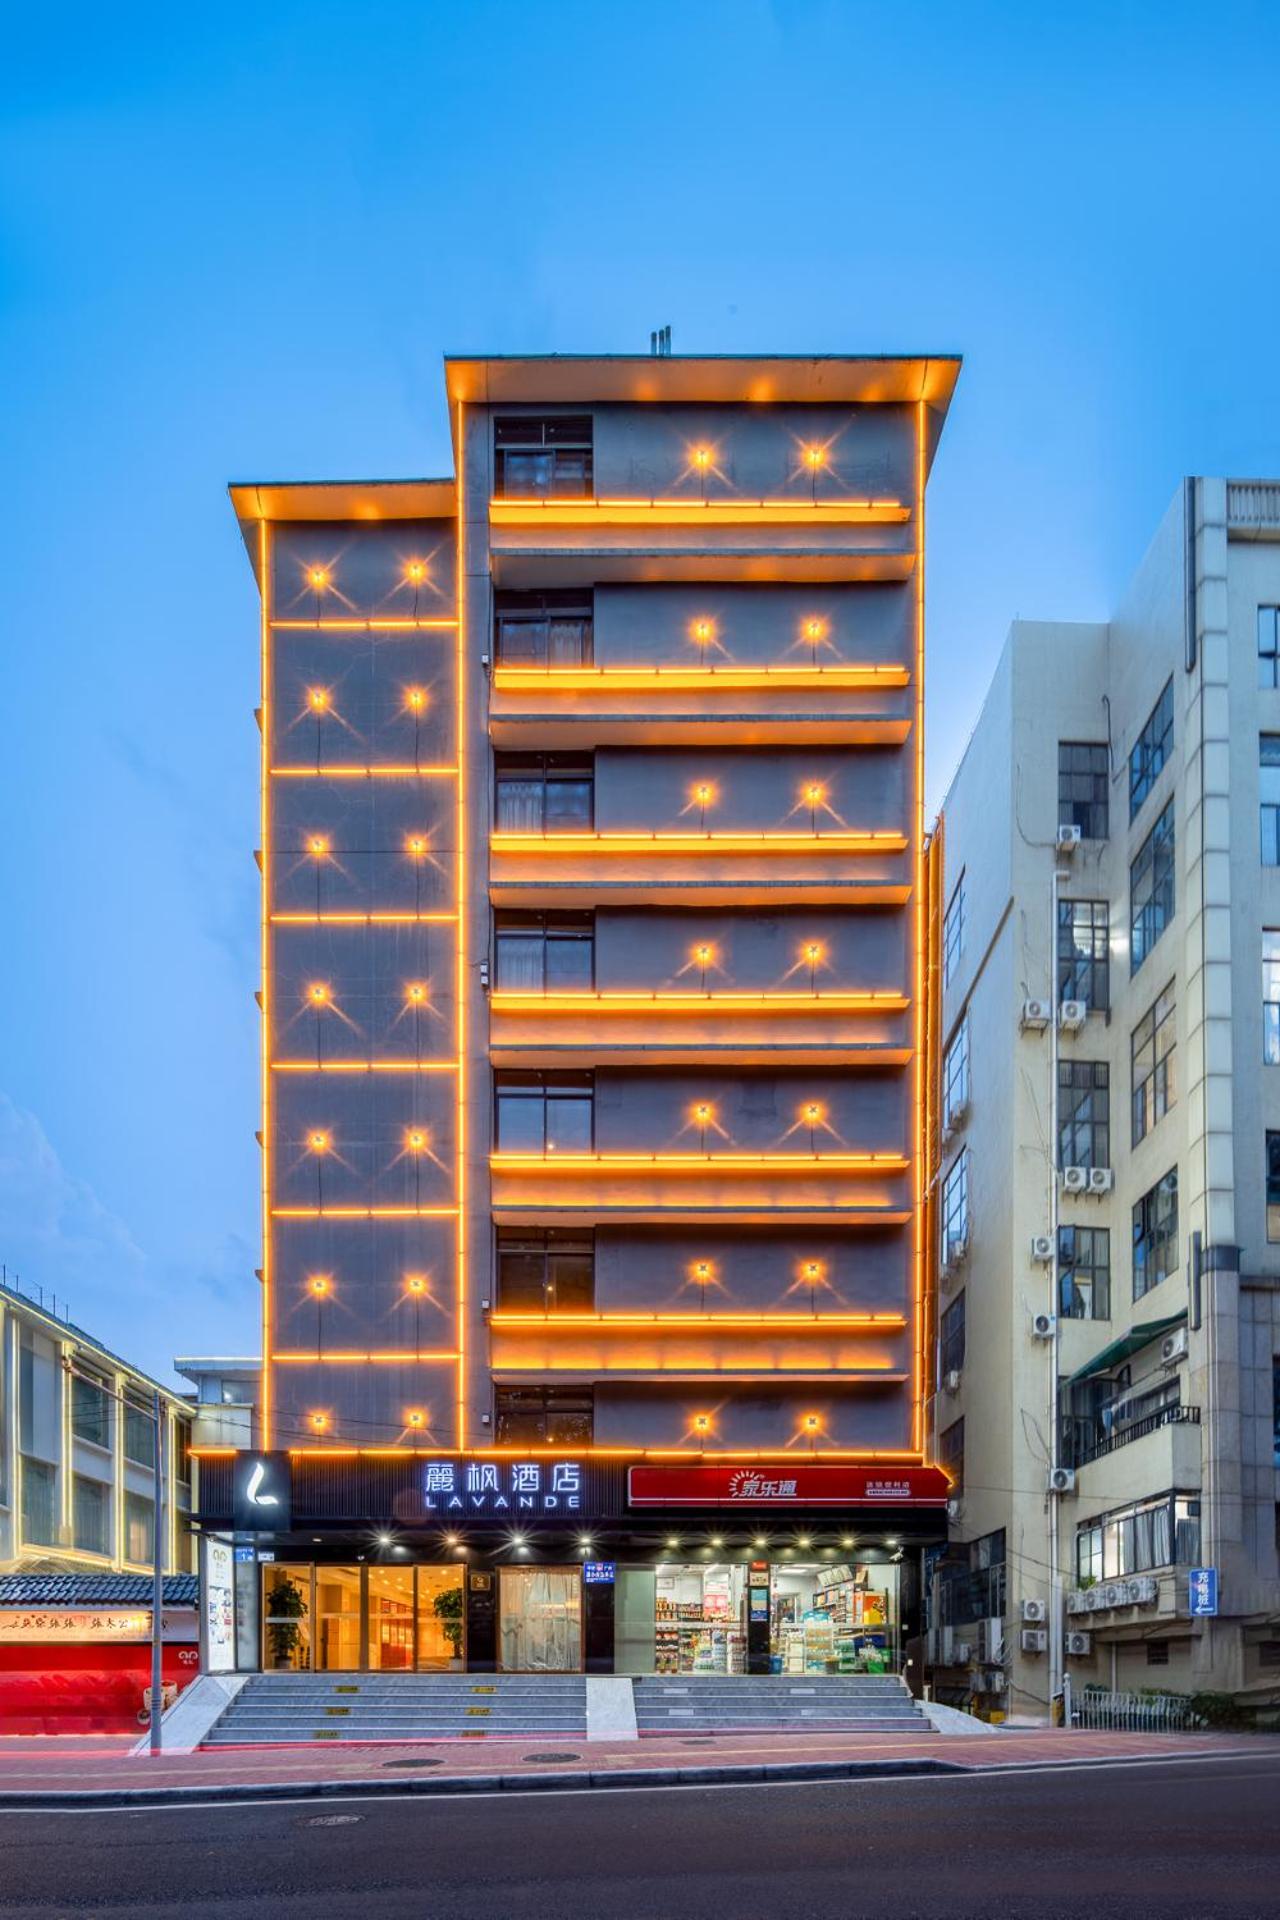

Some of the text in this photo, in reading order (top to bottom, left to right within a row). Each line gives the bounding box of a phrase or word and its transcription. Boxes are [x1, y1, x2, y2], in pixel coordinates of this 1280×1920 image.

[426, 1463, 580, 1492] 麗枫酒店
[739, 1480, 797, 1496] 家乐通
[425, 1496, 580, 1508] LAVANDE
[1198, 1572, 1208, 1606] 充电桩
